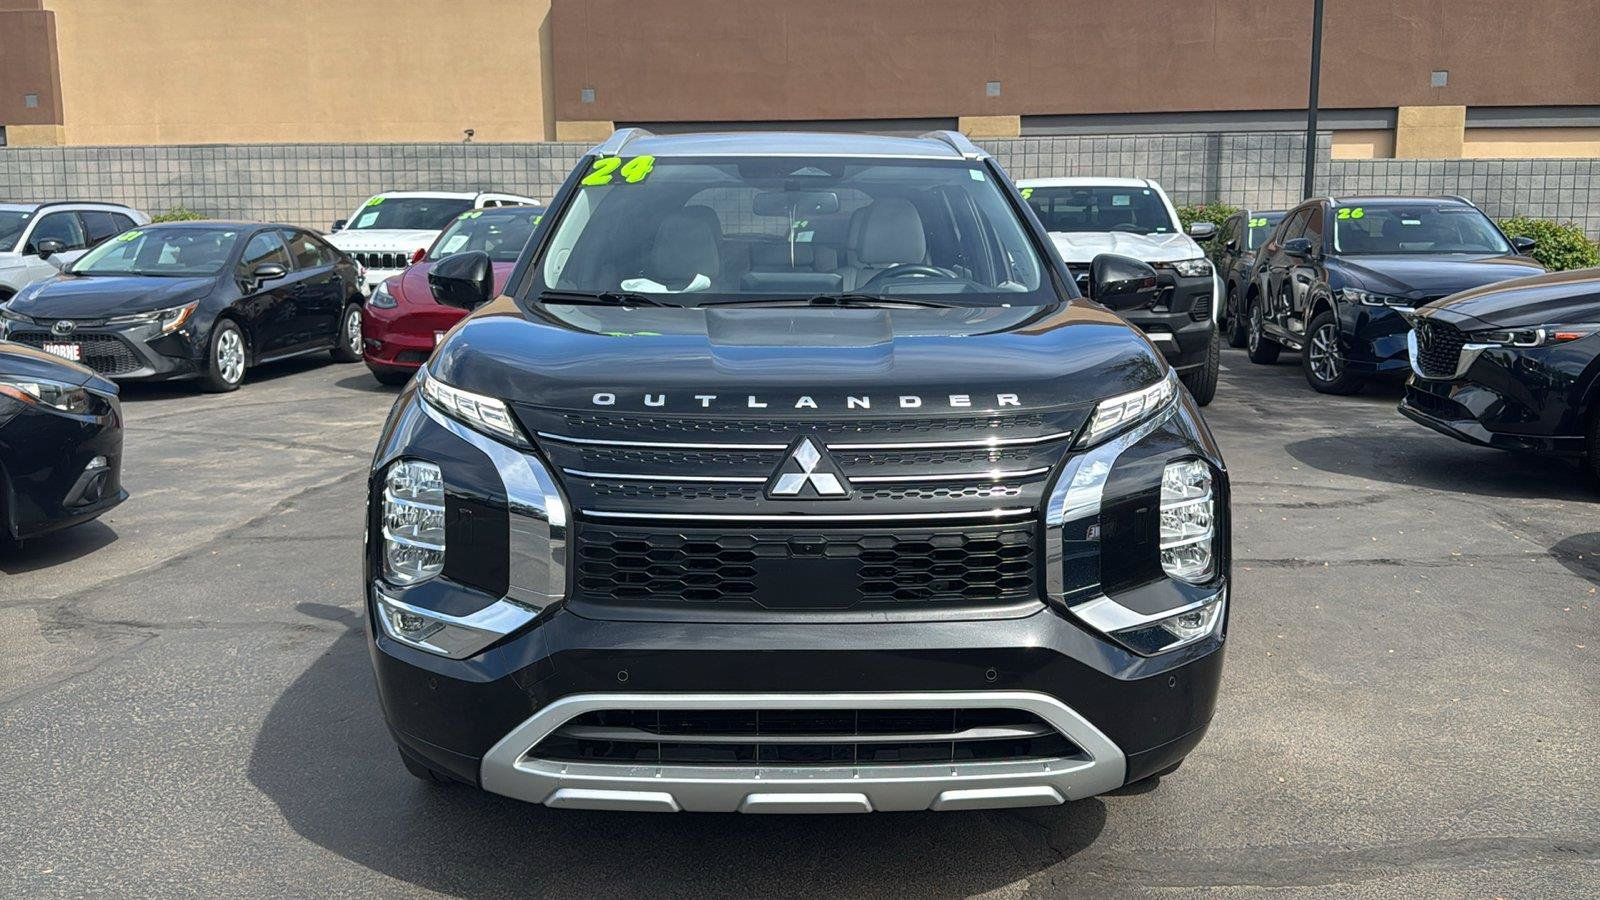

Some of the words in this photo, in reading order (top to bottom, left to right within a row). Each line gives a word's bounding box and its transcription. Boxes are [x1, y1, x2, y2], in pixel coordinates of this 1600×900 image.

[581, 155, 656, 186] 24
[1020, 188, 1034, 200] 5
[1338, 207, 1364, 219] 26
[592, 391, 1022, 409] OUTLANDER
